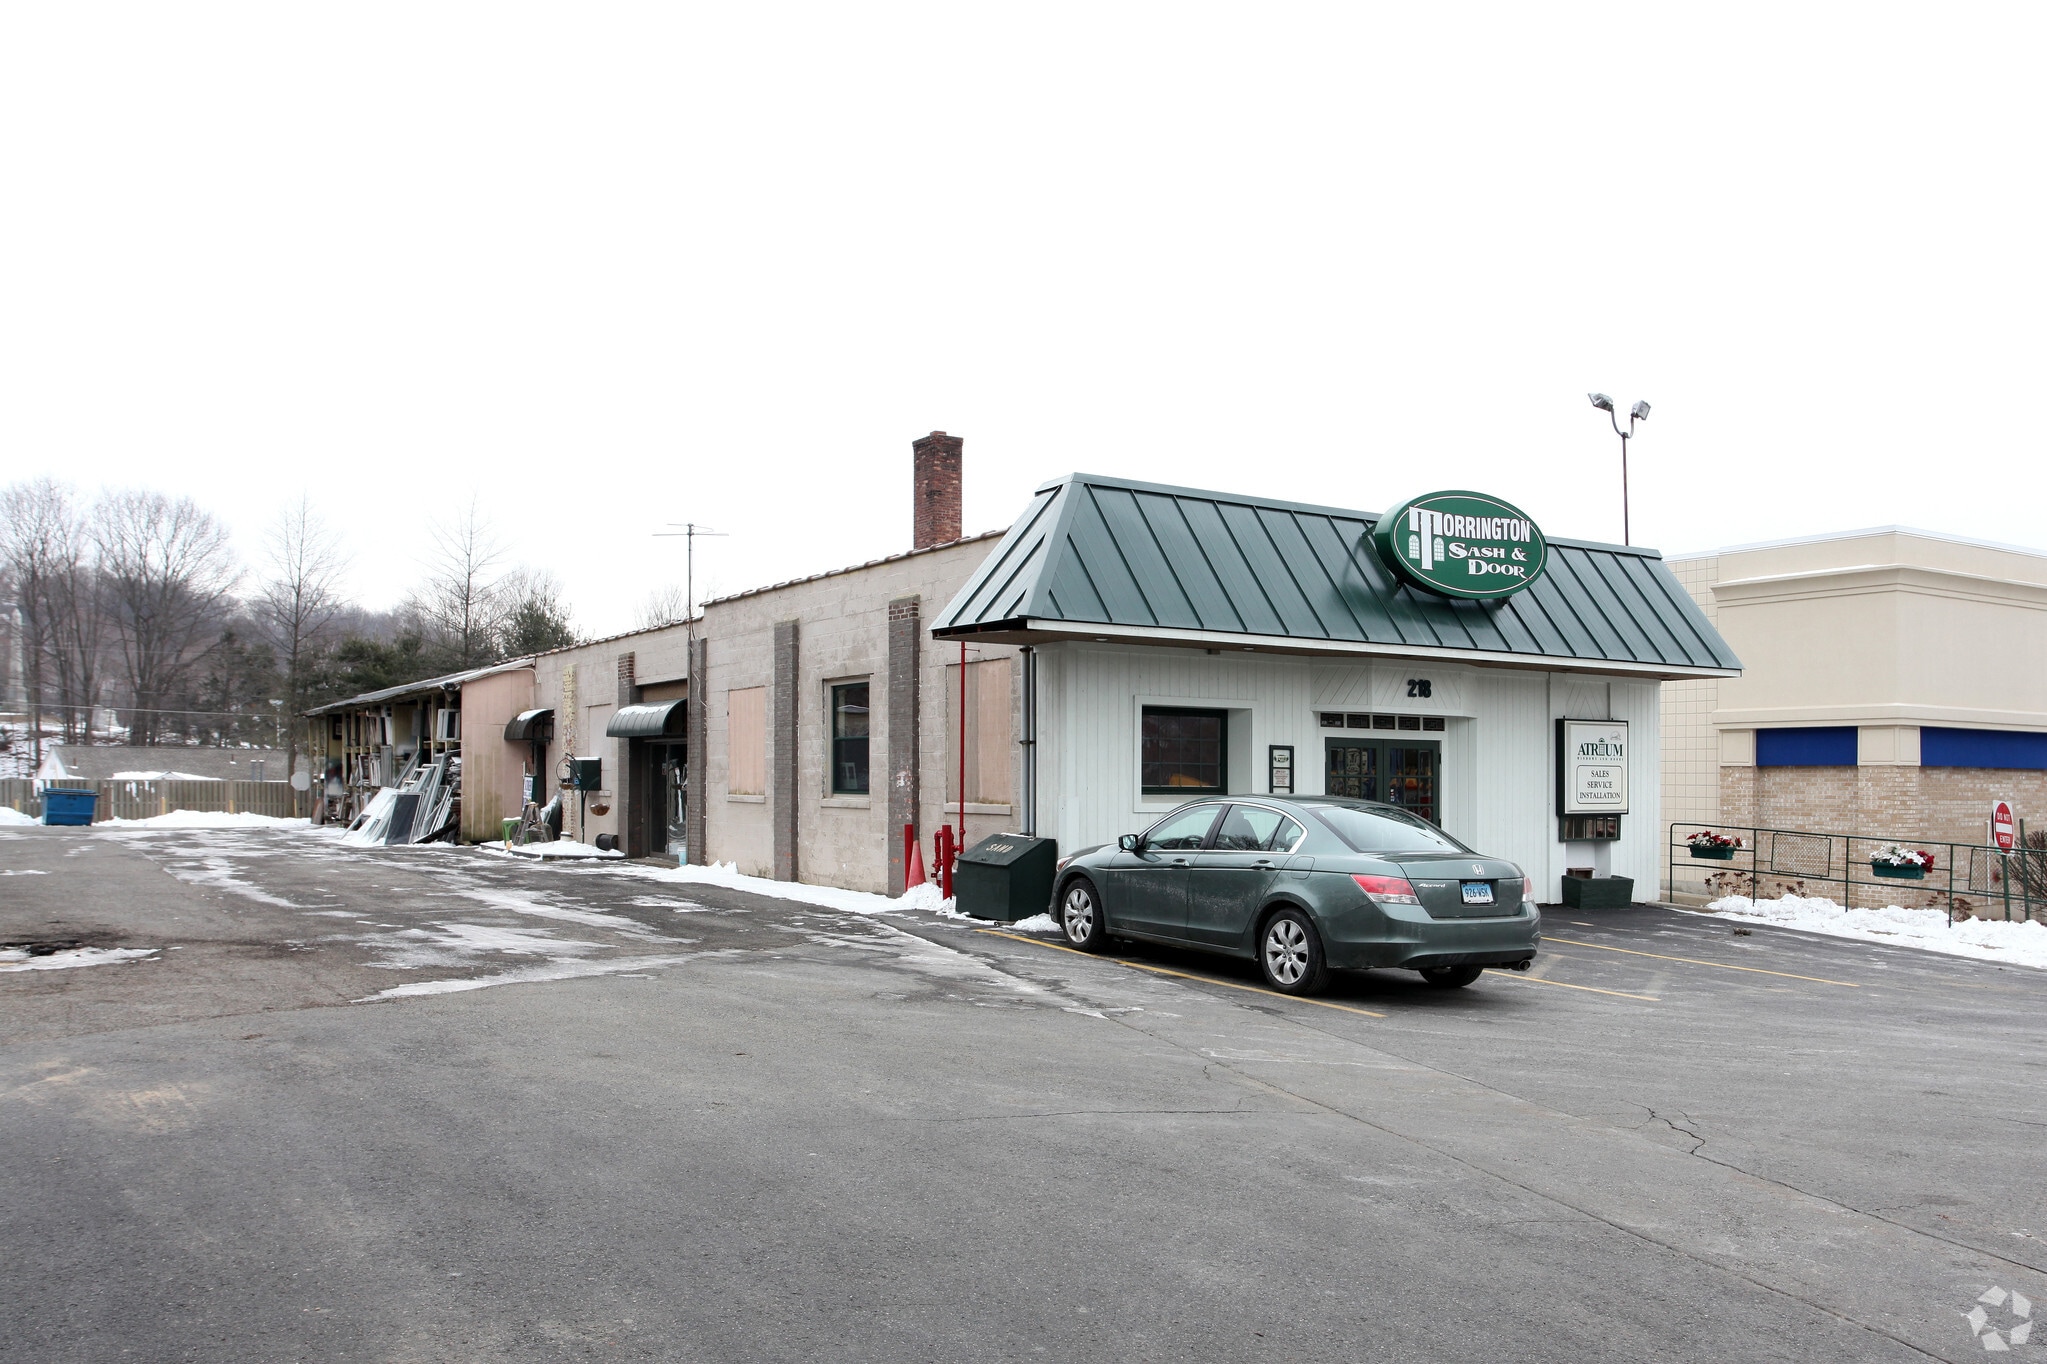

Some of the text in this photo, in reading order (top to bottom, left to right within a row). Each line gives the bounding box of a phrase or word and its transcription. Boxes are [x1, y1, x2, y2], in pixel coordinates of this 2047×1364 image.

[1408, 506, 1531, 570] TORRINGTON
[1449, 542, 1528, 561] SASH &
[1468, 559, 1531, 580] DOOR
[986, 843, 1015, 853] SAND
